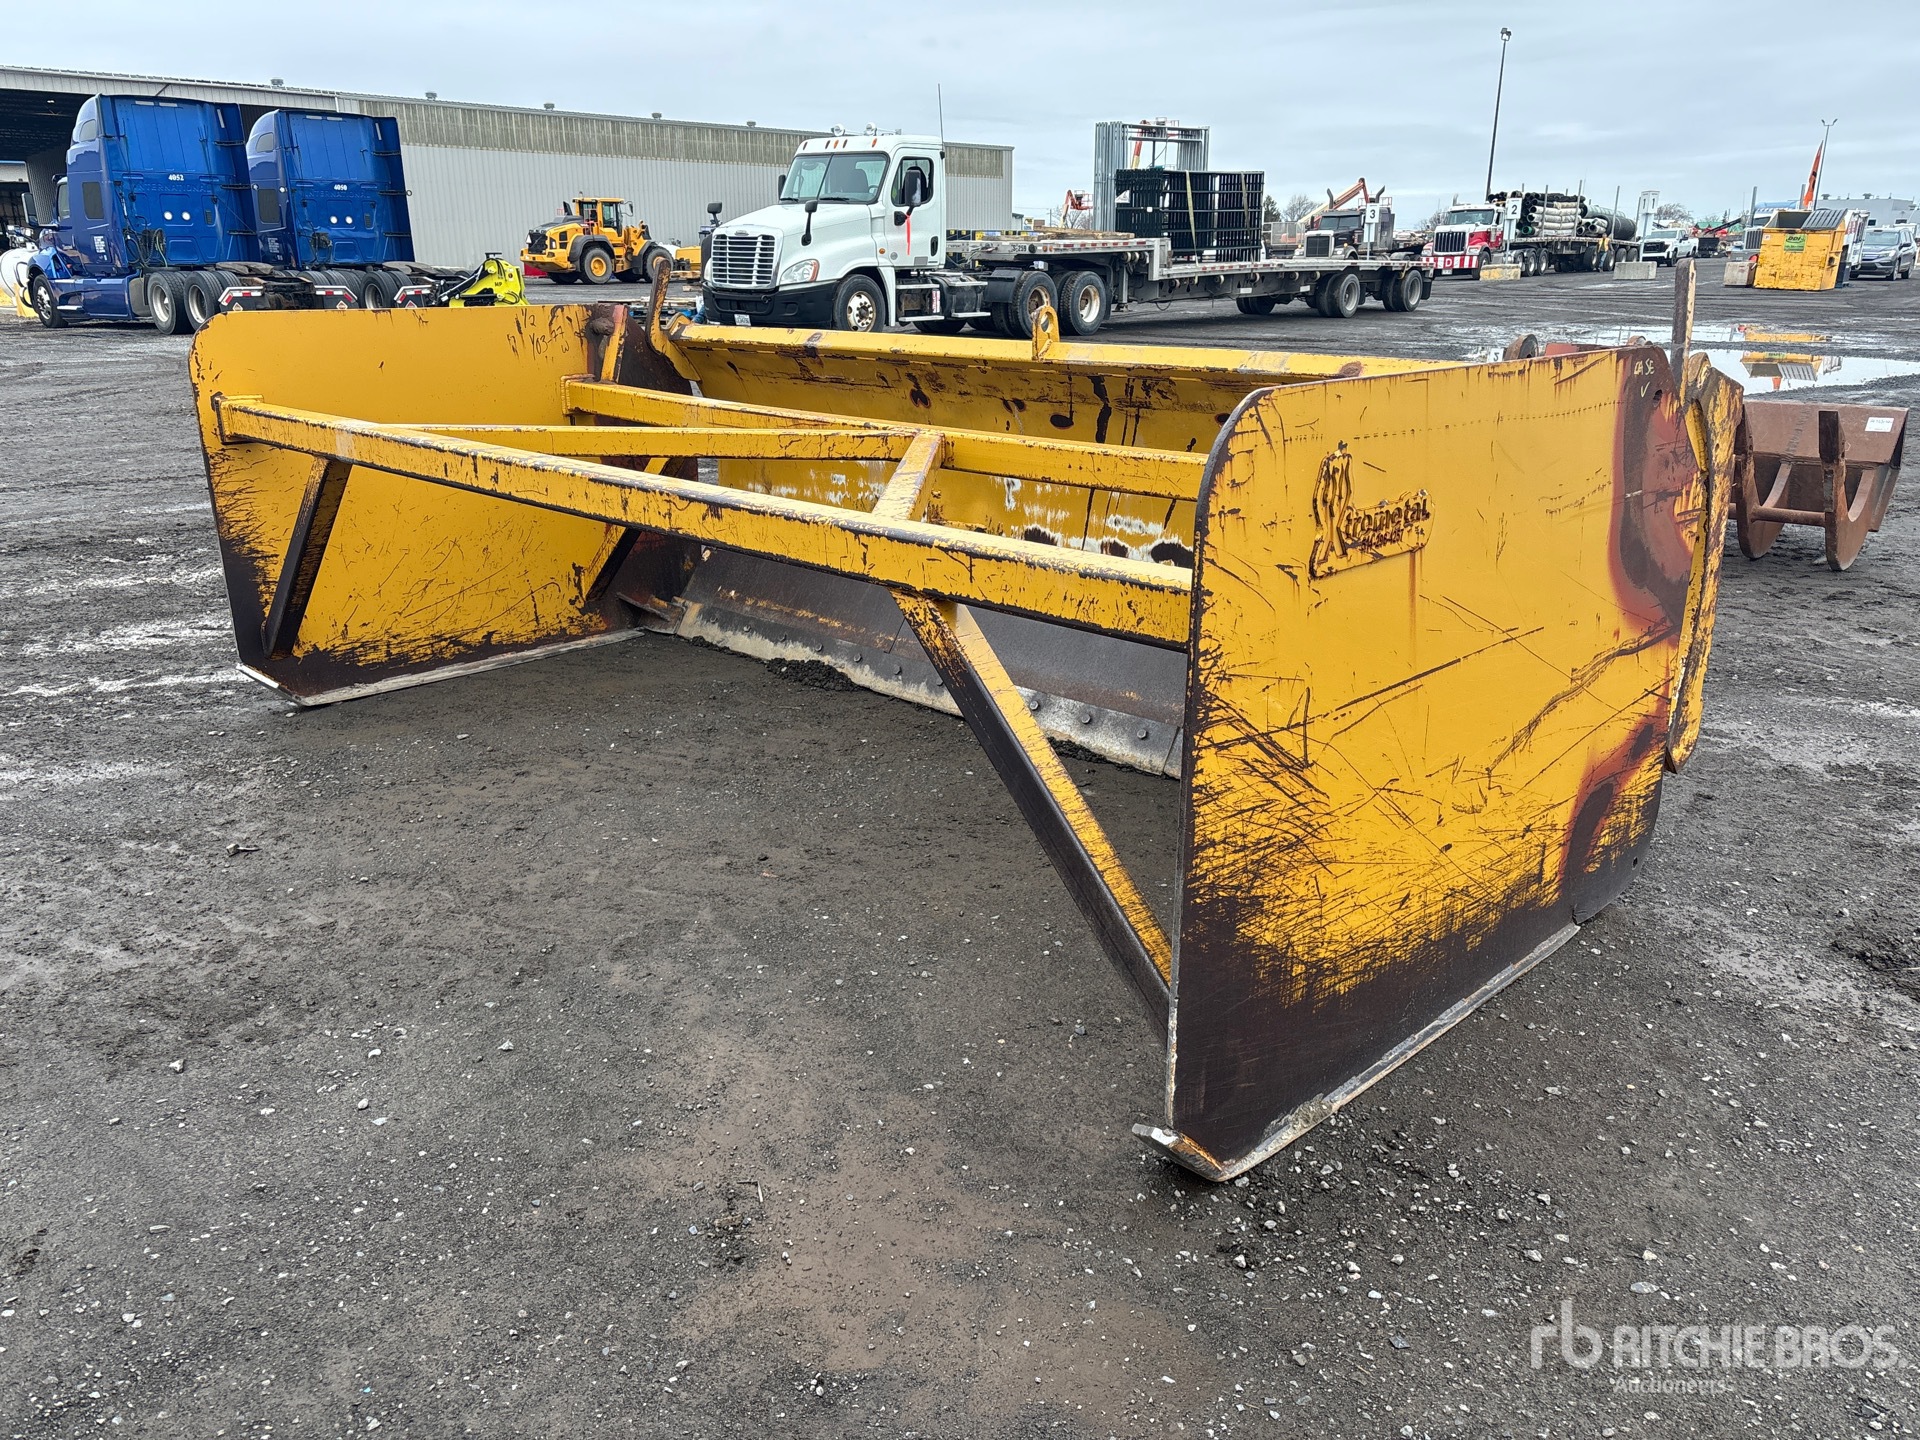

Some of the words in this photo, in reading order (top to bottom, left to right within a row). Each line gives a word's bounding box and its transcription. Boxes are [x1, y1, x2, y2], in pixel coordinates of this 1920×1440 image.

[1369, 209, 1376, 219] 3
[1511, 204, 1518, 215] 2
[1445, 257, 1453, 267] D
